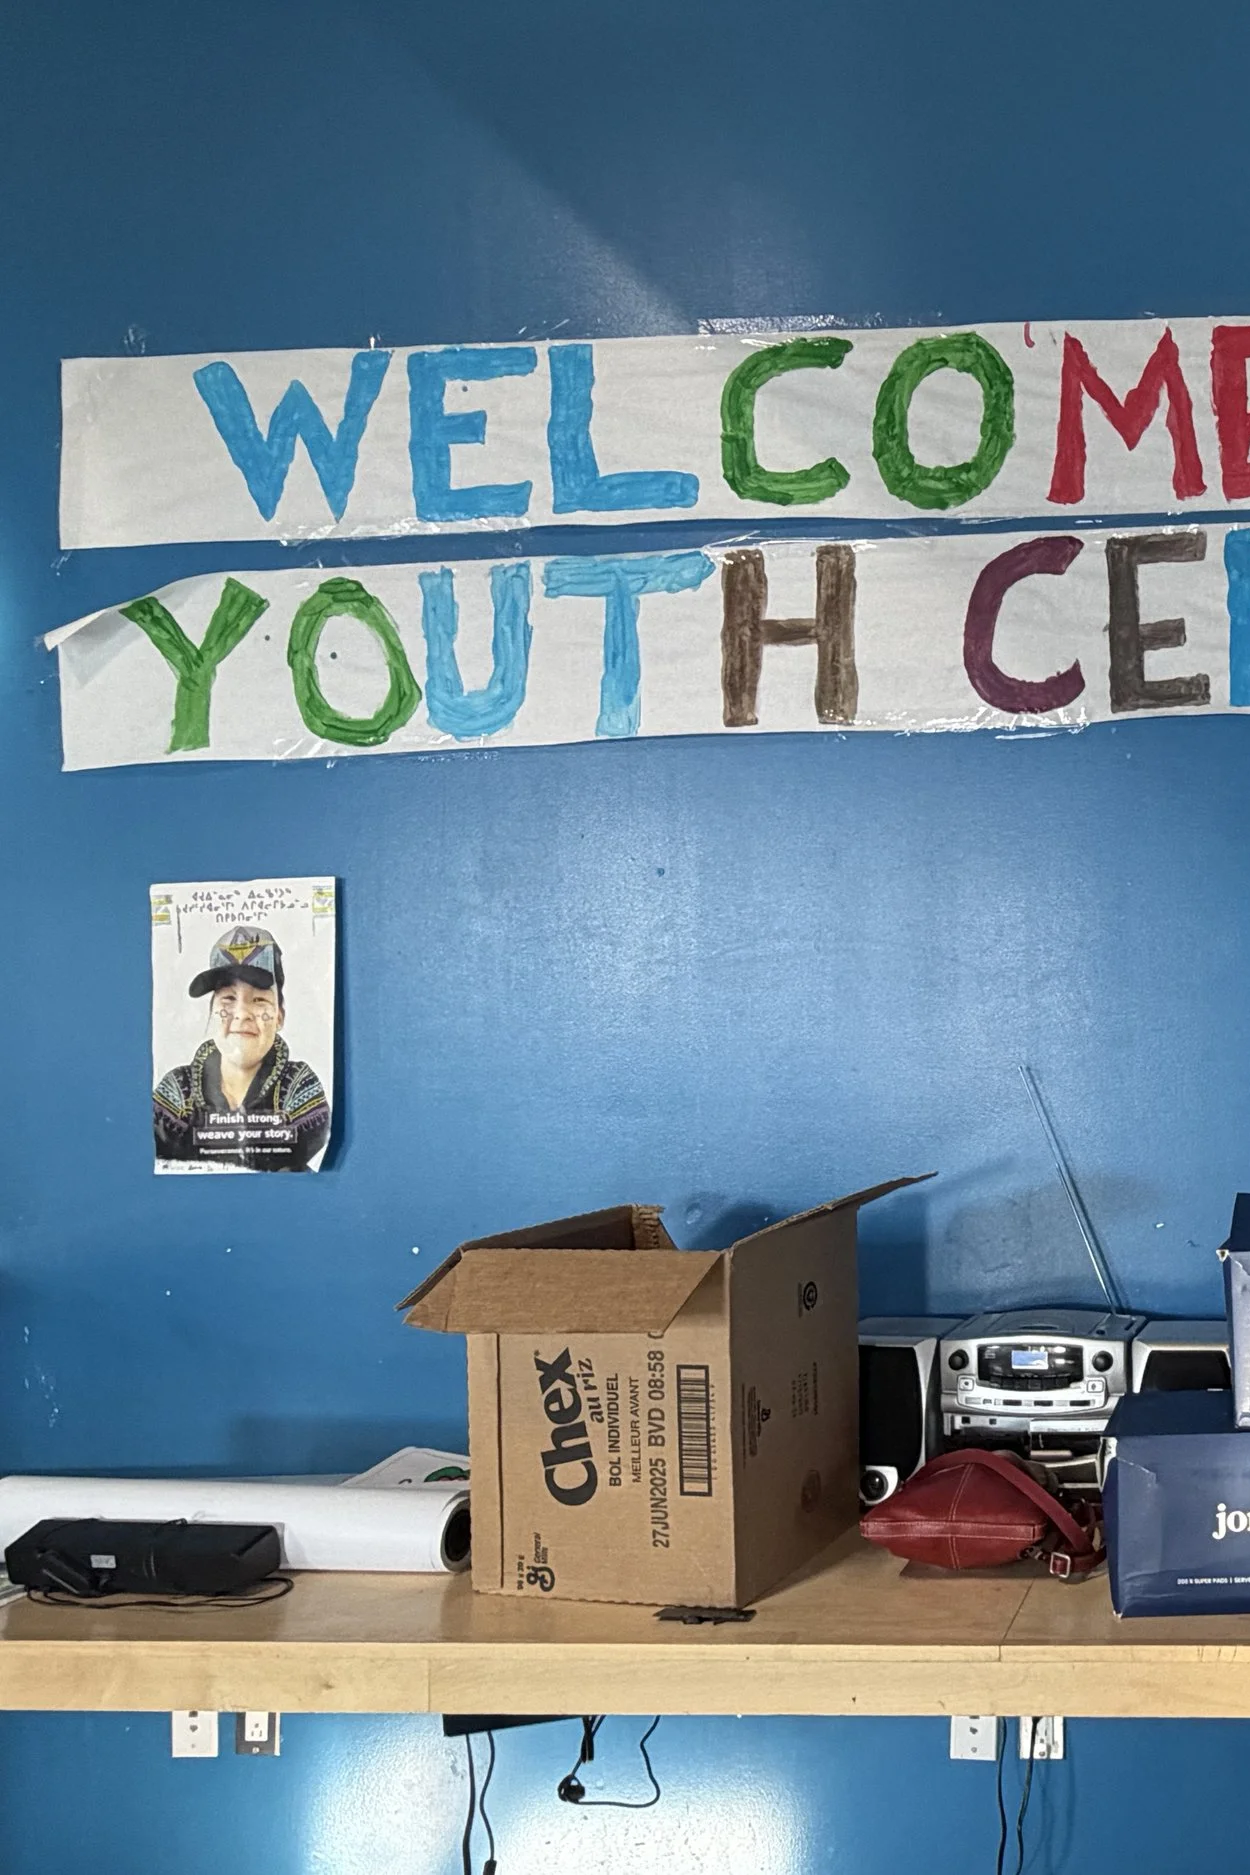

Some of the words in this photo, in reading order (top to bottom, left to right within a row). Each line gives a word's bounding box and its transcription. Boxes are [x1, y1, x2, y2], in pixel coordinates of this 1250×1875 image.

[117, 543, 858, 754] YOUTH
[196, 1130, 235, 1140] weave
[238, 1130, 262, 1142] your
[264, 1129, 294, 1141] story.
[208, 1112, 244, 1125] Finish
[577, 1357, 598, 1392] riz
[647, 1349, 665, 1401] 08:58
[586, 1396, 605, 1424] au
[606, 1372, 621, 1454] INDIVIDUEL
[628, 1375, 640, 1418] AVANT
[534, 1346, 598, 1507] Chex
[648, 1407, 666, 1448] BVD
[609, 1456, 622, 1487] BOL
[629, 1424, 642, 1484] MEILLEUR
[648, 1457, 670, 1549] 27JUN2025
